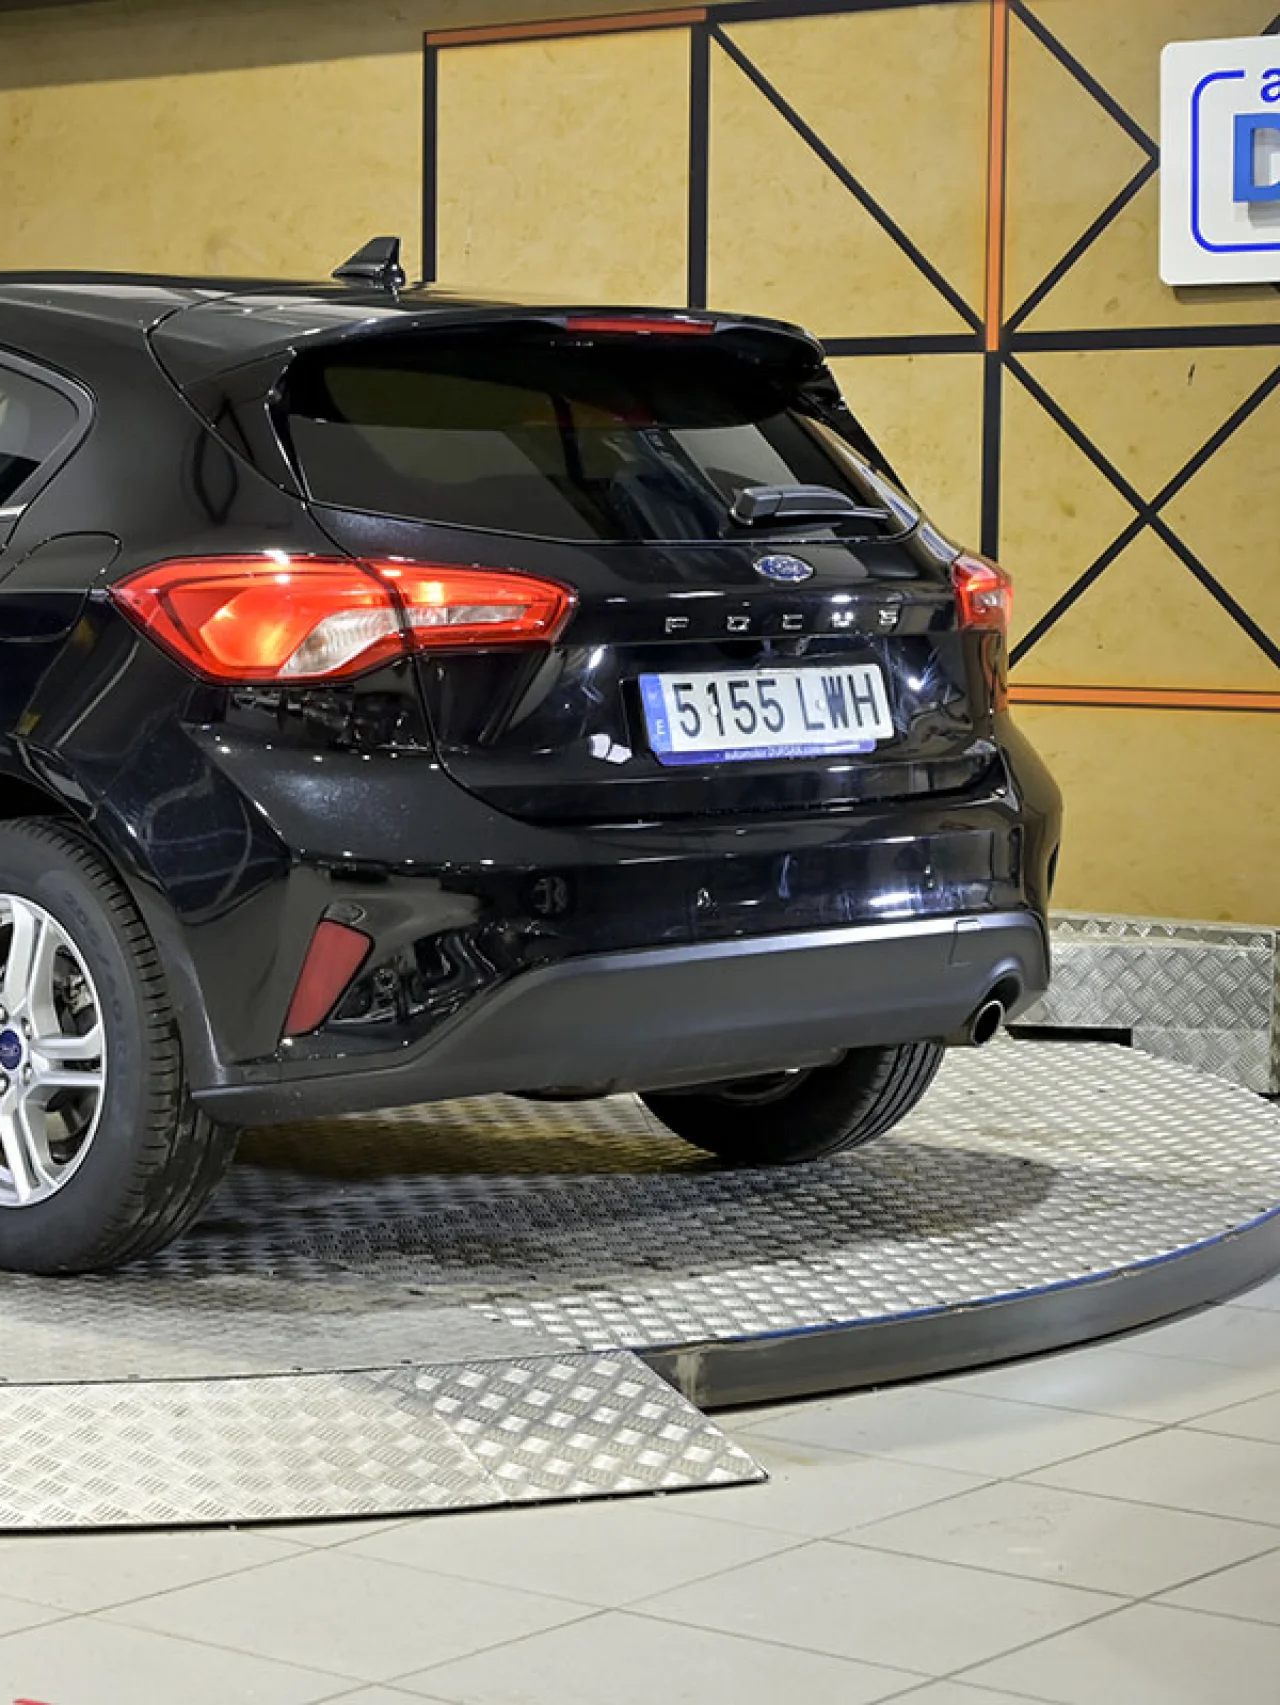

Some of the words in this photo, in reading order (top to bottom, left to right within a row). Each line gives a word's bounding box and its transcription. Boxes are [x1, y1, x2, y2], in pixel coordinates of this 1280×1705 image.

[666, 610, 897, 632] FOCUS
[672, 679, 786, 737] 5155
[796, 672, 881, 730] LWH
